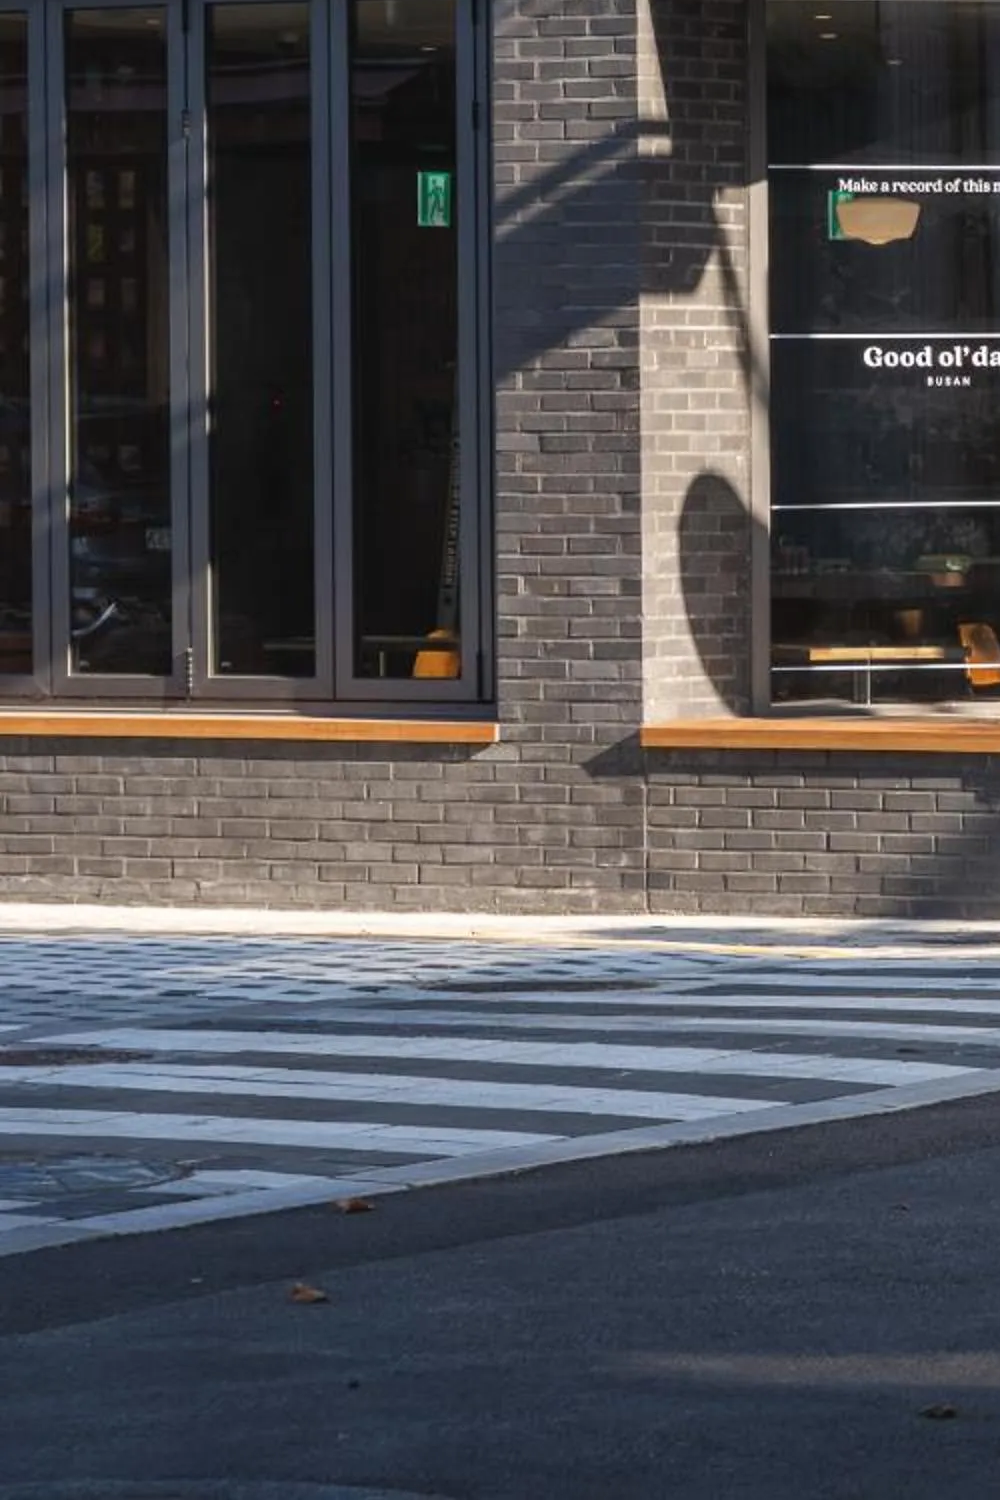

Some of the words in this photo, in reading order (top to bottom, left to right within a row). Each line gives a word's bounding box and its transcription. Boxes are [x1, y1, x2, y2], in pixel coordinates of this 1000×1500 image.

[838, 178, 877, 193] Make
[880, 182, 890, 193] a
[892, 178, 943, 193] record
[944, 178, 962, 193] of
[963, 178, 991, 193] this
[863, 345, 933, 368] Good
[926, 375, 972, 387] BUSAN
